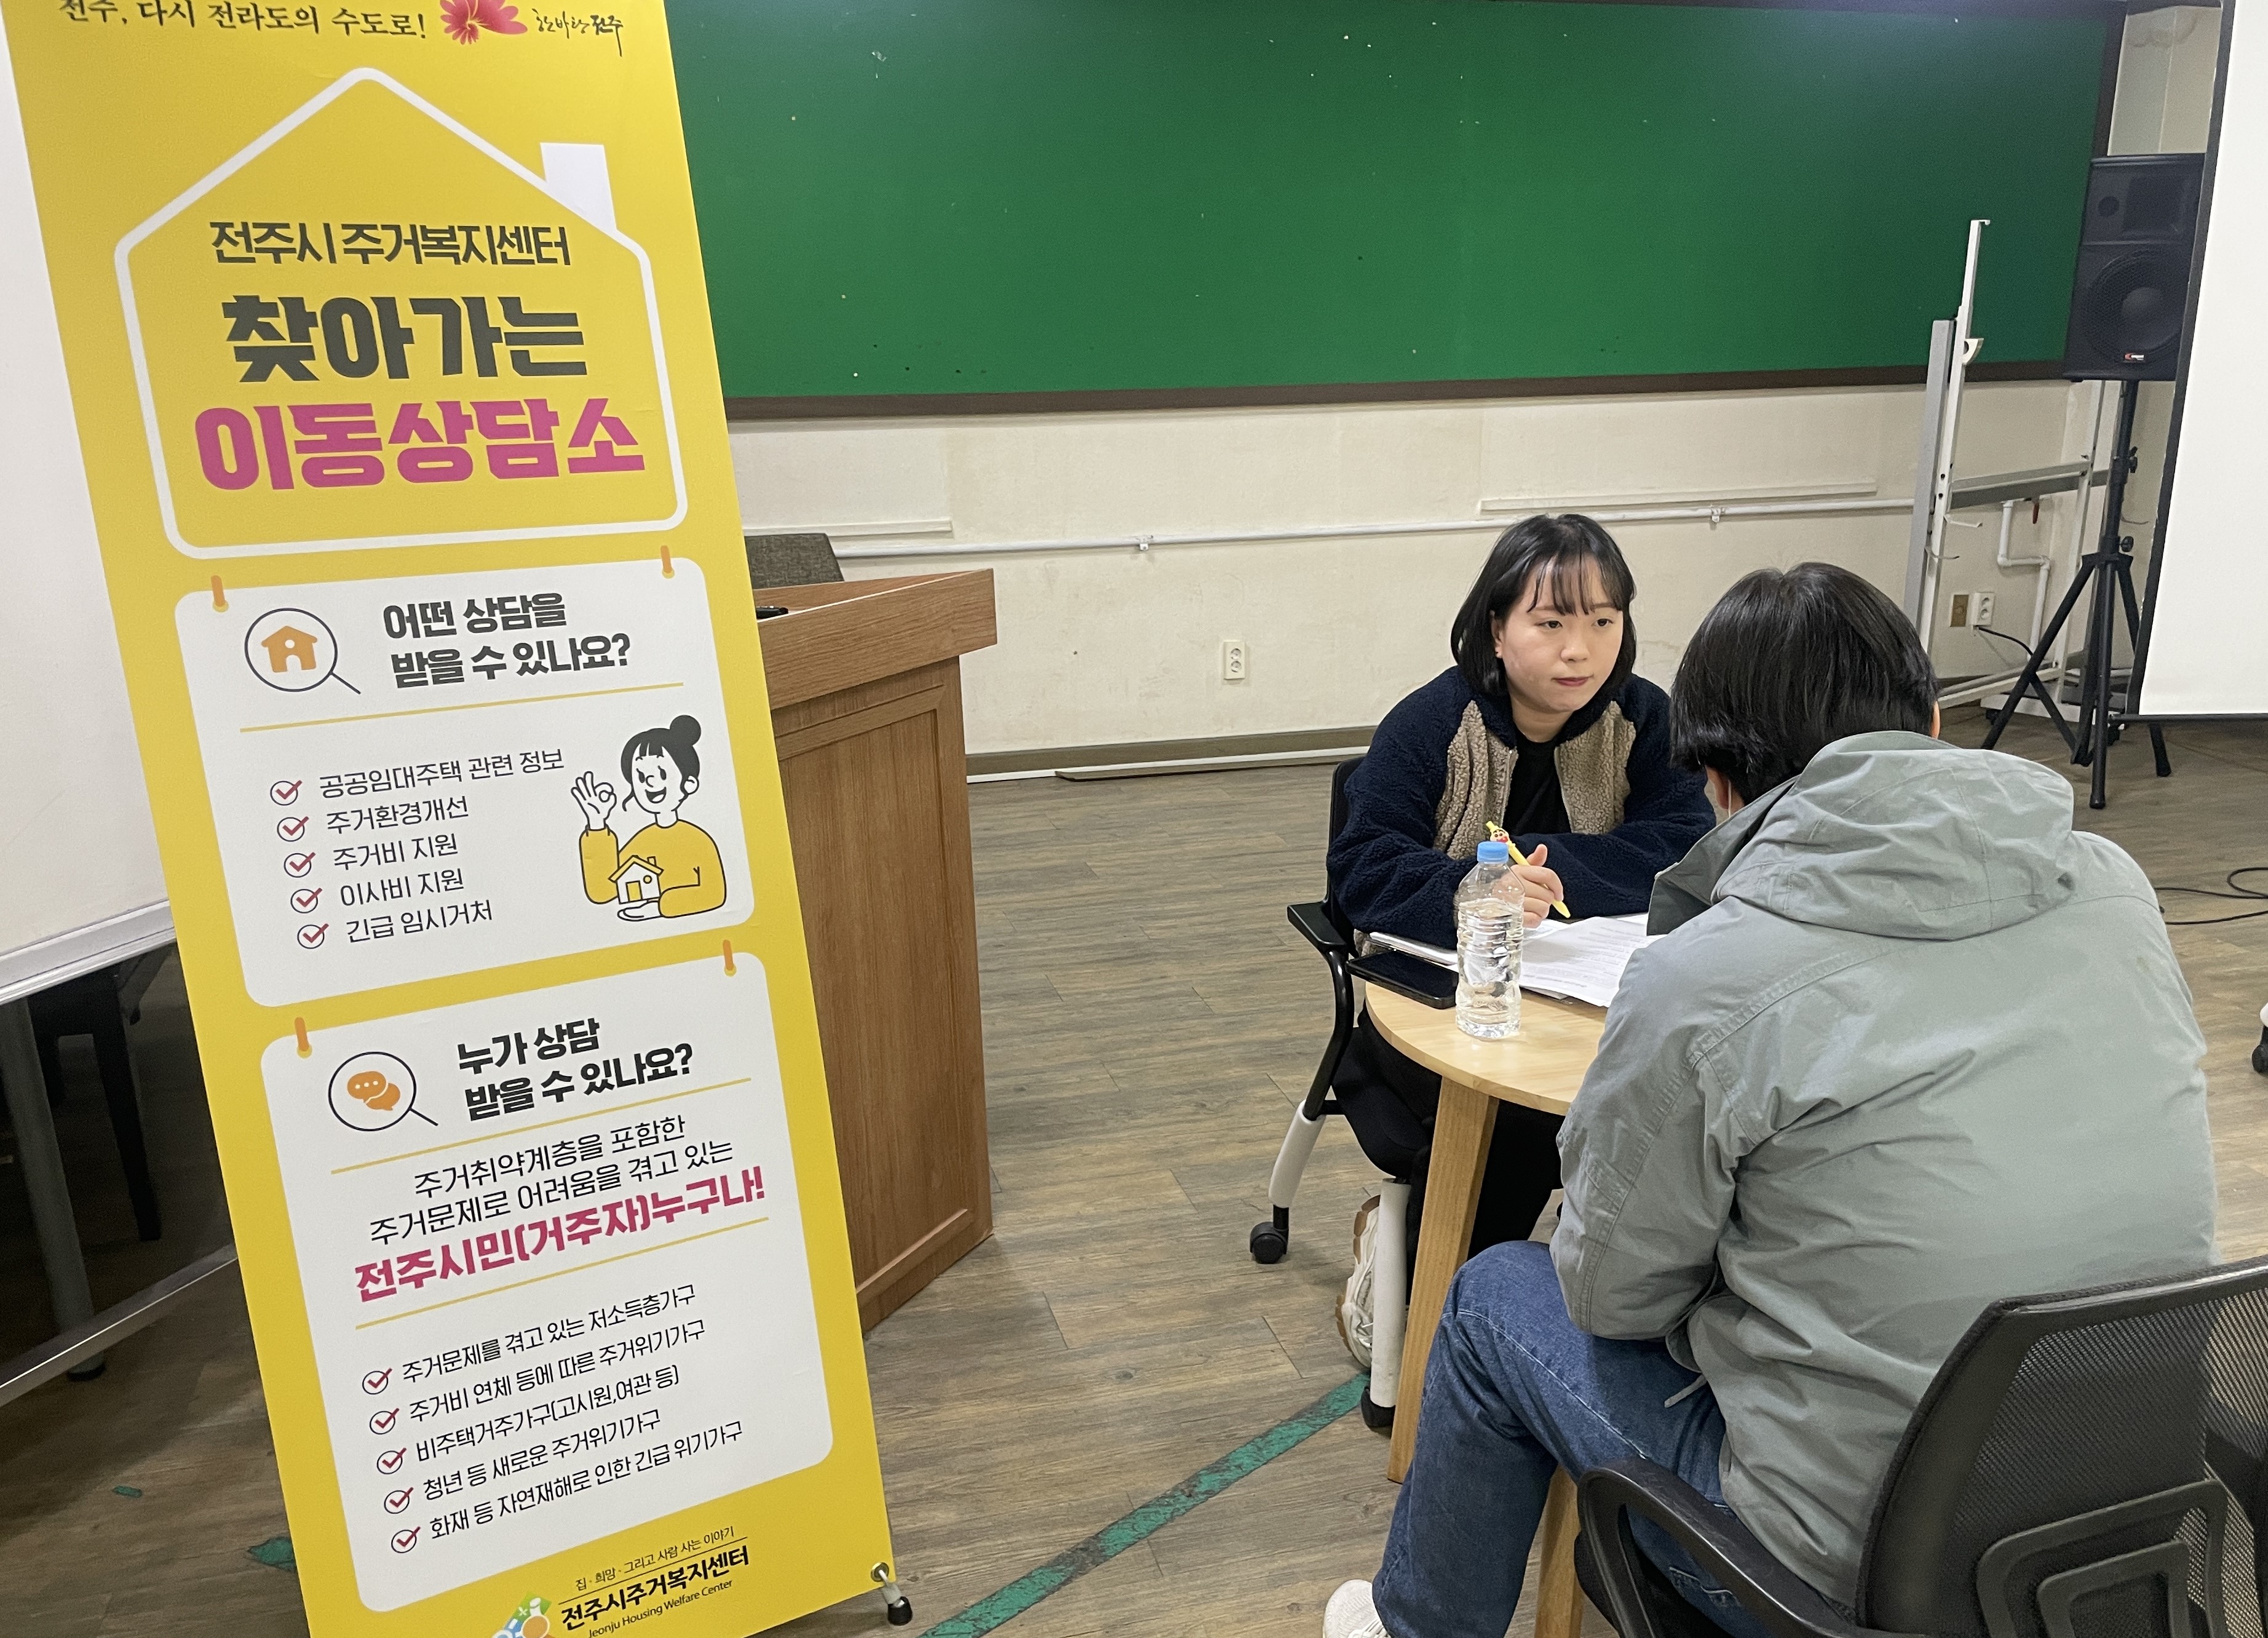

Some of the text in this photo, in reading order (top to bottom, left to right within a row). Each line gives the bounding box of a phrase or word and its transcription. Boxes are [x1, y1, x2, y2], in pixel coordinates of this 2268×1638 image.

[137, 0, 195, 28] 다시
[207, 1, 319, 34] 전라도의
[331, 7, 426, 39] 수도로!
[210, 221, 571, 266] 전주시 주거복지센터
[221, 295, 587, 383] 찾아가는
[195, 398, 645, 490] 이동상담소
[383, 593, 566, 638] 어떤 상담을
[391, 633, 630, 688] 받을 수 있나요?
[320, 749, 564, 798] 공공임대주택 관련 정보
[327, 796, 469, 834] 주거환경개선
[333, 833, 458, 870] 주거비 지원
[341, 868, 464, 906] 이사비 지원
[346, 899, 492, 943] 긴급 임시거처
[458, 1017, 600, 1075] 누가 상담
[465, 1043, 692, 1121] 받을 수 있나요?
[414, 1115, 685, 1198] 주거취약계층을 포함한
[370, 1141, 732, 1245] 주거문제로 어려움을 겪고 있는
[402, 1284, 695, 1383] 주거문제를 겪고 있는 저소득층가구
[410, 1319, 705, 1422] 주거비 연체 등에 따른 주거위기가구
[423, 1409, 660, 1500] 청년 등 새로운 주거위기가구
[430, 1421, 742, 1539] 화재 등 자연재해로 인한 긴급 위기가구
[561, 1545, 748, 1631] 전주시주거복지센터
[574, 1575, 587, 1591] 집
[595, 1567, 616, 1583] 희망
[624, 1554, 656, 1574] 그리고
[657, 1545, 678, 1562] 사람
[681, 1540, 702, 1553] 사는
[704, 1526, 734, 1543] 이야기
[589, 1580, 732, 1638] Jeonju Housing Welfare Center
